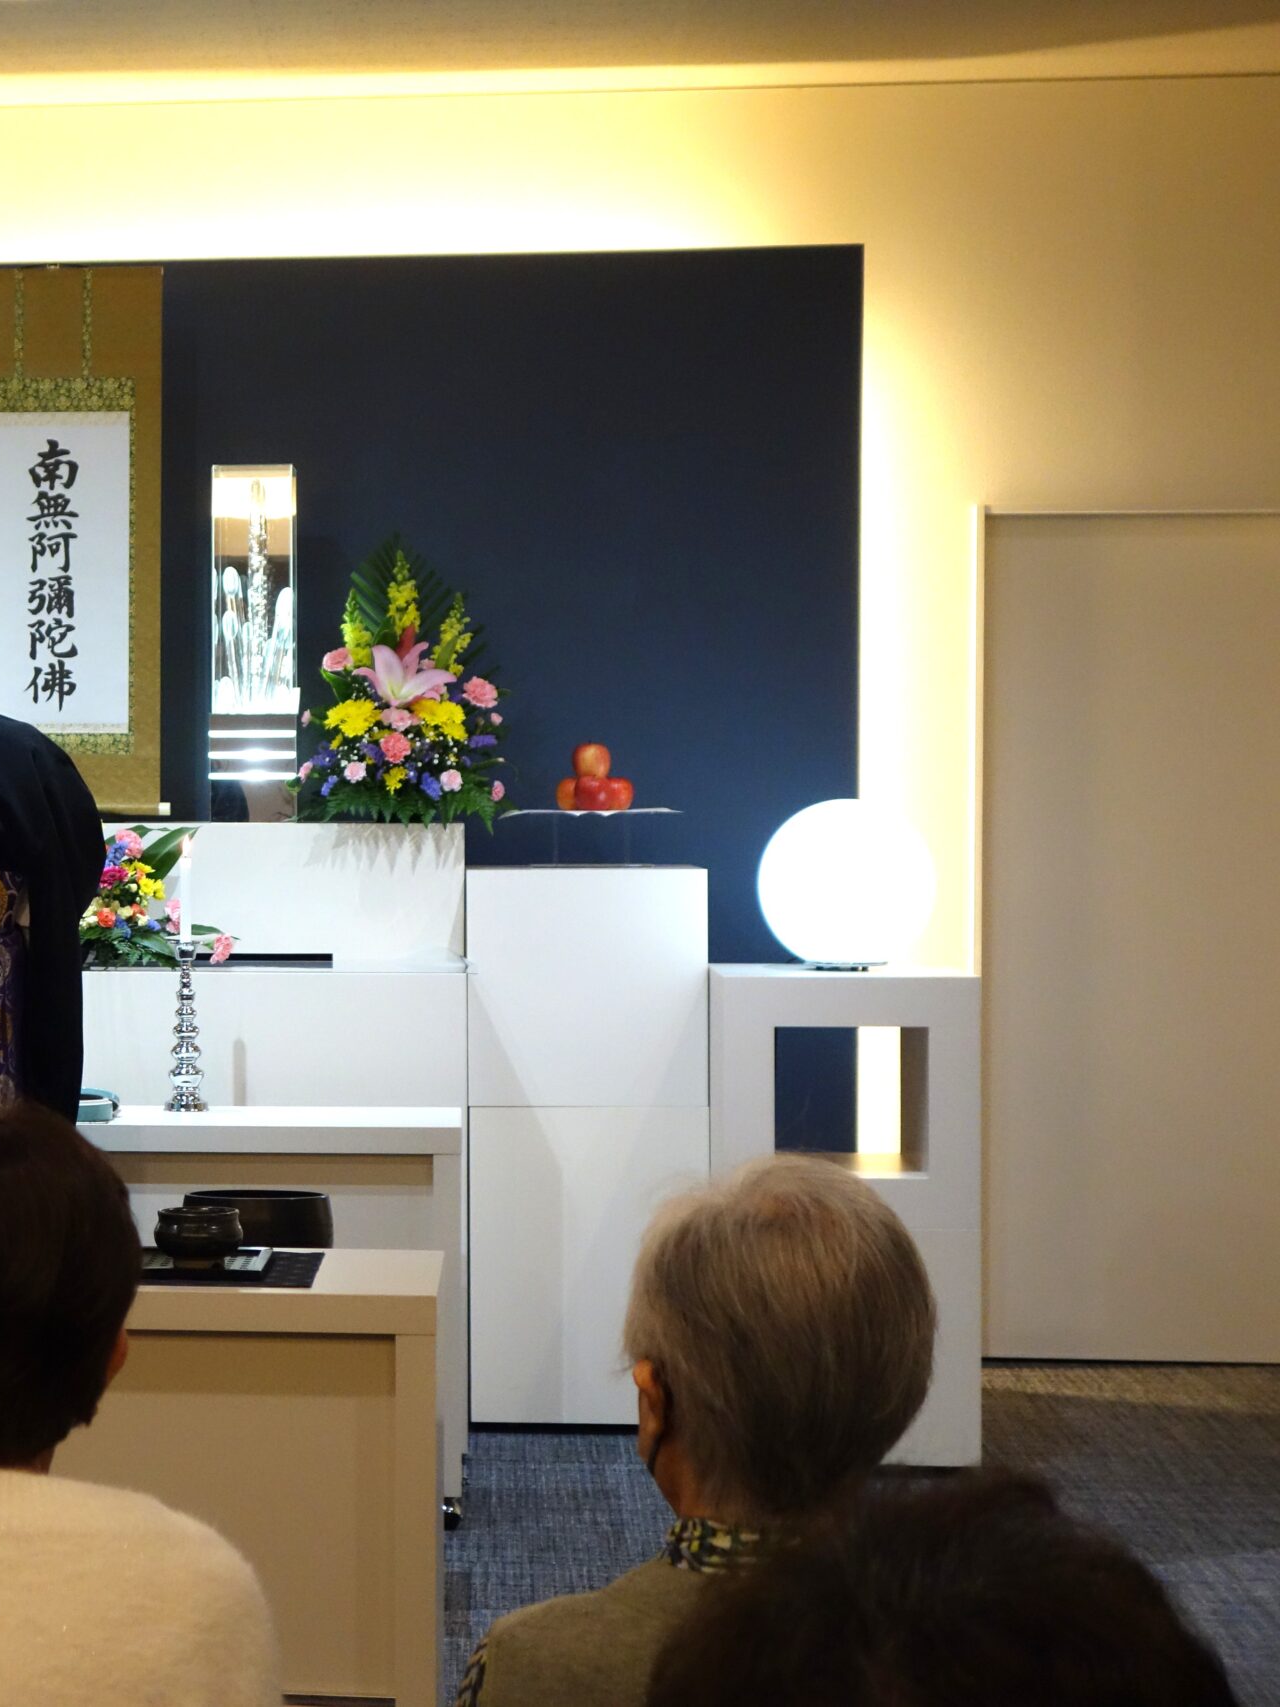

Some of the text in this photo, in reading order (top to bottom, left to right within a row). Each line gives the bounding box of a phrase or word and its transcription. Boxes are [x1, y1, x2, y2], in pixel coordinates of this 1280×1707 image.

[24, 439, 79, 712] 南無阿彌陀佛
